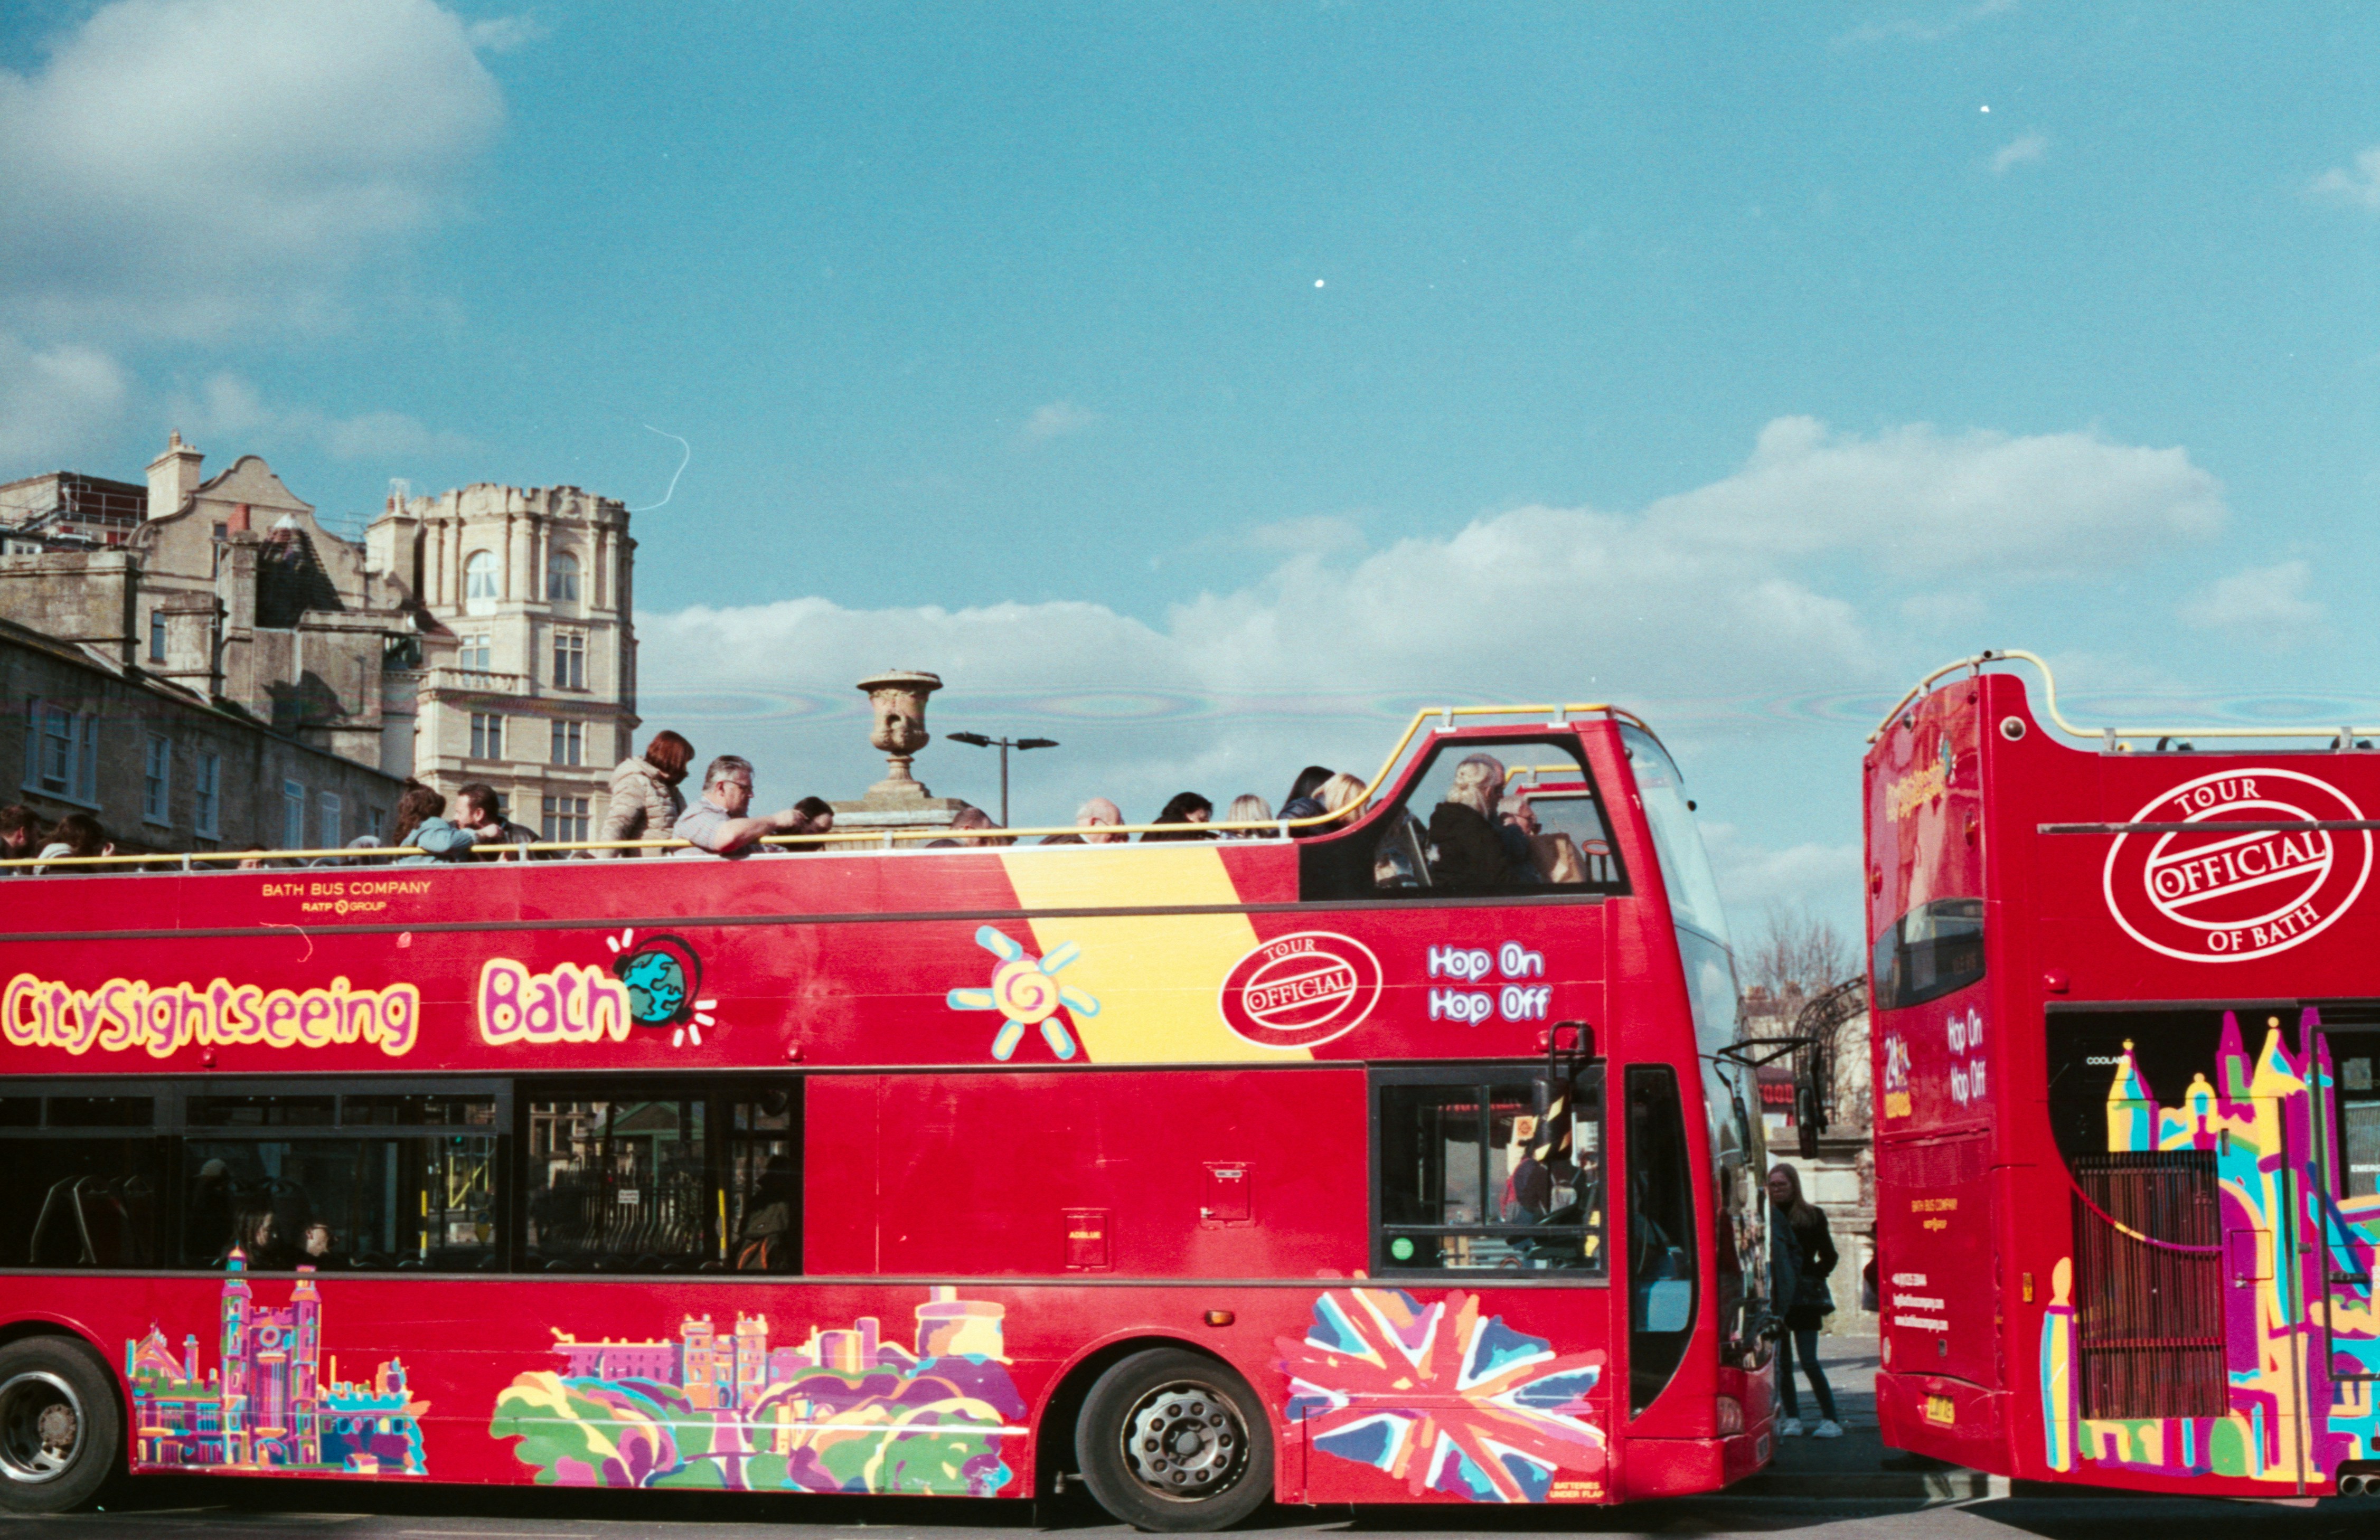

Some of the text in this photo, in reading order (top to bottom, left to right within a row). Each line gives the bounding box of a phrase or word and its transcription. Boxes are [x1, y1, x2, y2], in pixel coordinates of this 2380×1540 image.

[2174, 778, 2261, 816] TOUR
[2155, 831, 2327, 898] OFFICIAL
[262, 881, 432, 896] BATH BUS COMPANY
[302, 901, 387, 912] RATP GROUP
[2207, 902, 2320, 952] OF BATH
[1263, 939, 1316, 961] TOUR
[1428, 941, 1545, 983] Hop On
[477, 958, 632, 1045] Bath
[1248, 972, 1352, 1010] OFFICIAL
[1428, 984, 1554, 1026] Hop Off
[1947, 1007, 1983, 1056] Hop On
[1950, 1065, 1969, 1107] Hop
[1970, 1059, 1987, 1099] Off
